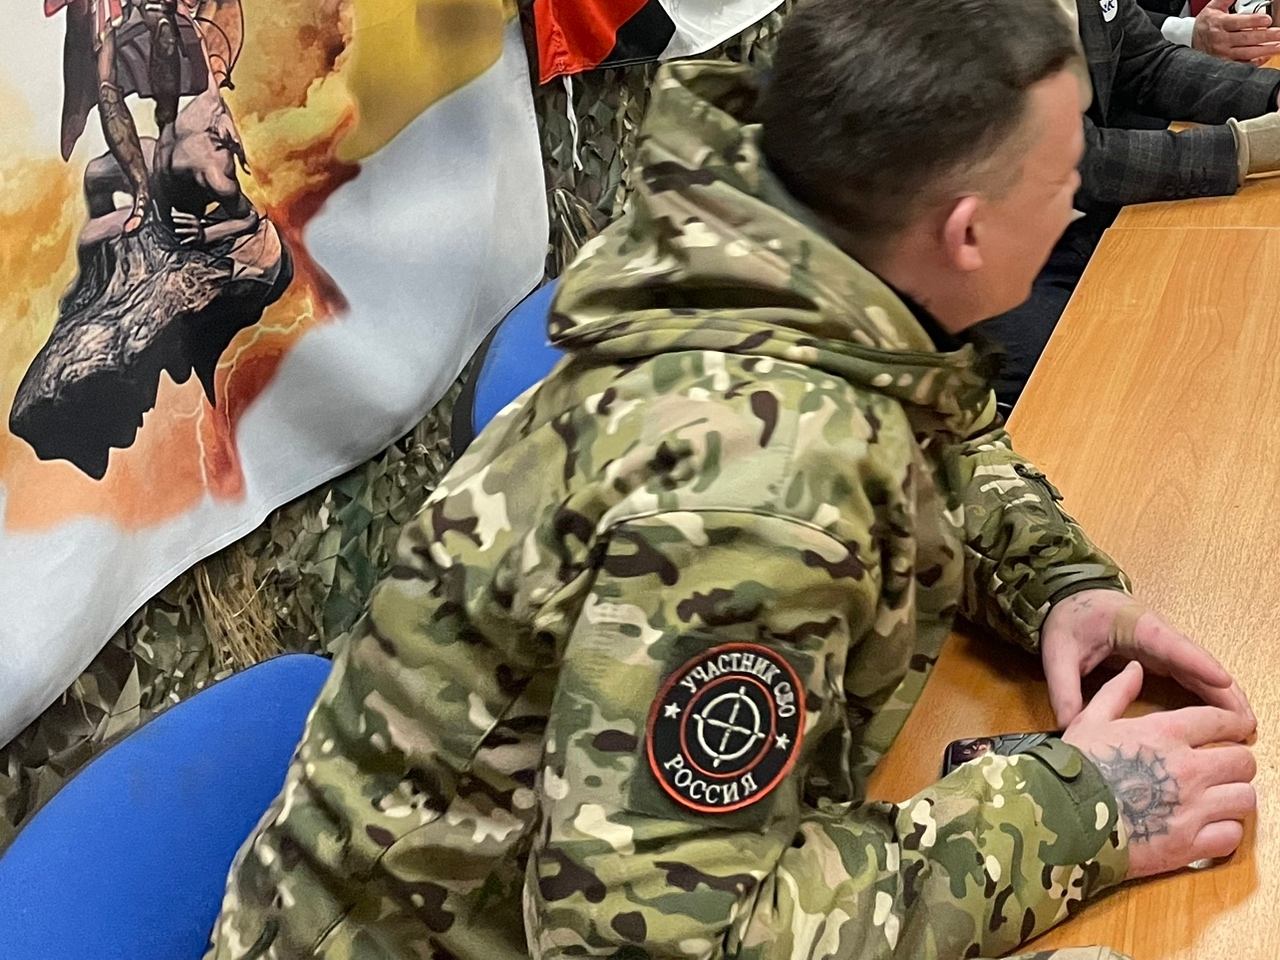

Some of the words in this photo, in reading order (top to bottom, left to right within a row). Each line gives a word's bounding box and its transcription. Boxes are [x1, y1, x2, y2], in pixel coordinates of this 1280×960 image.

[680, 653, 781, 694] УЧАСТНИК
[773, 681, 796, 718] СВО
[664, 753, 758, 804] РОССИЯ
